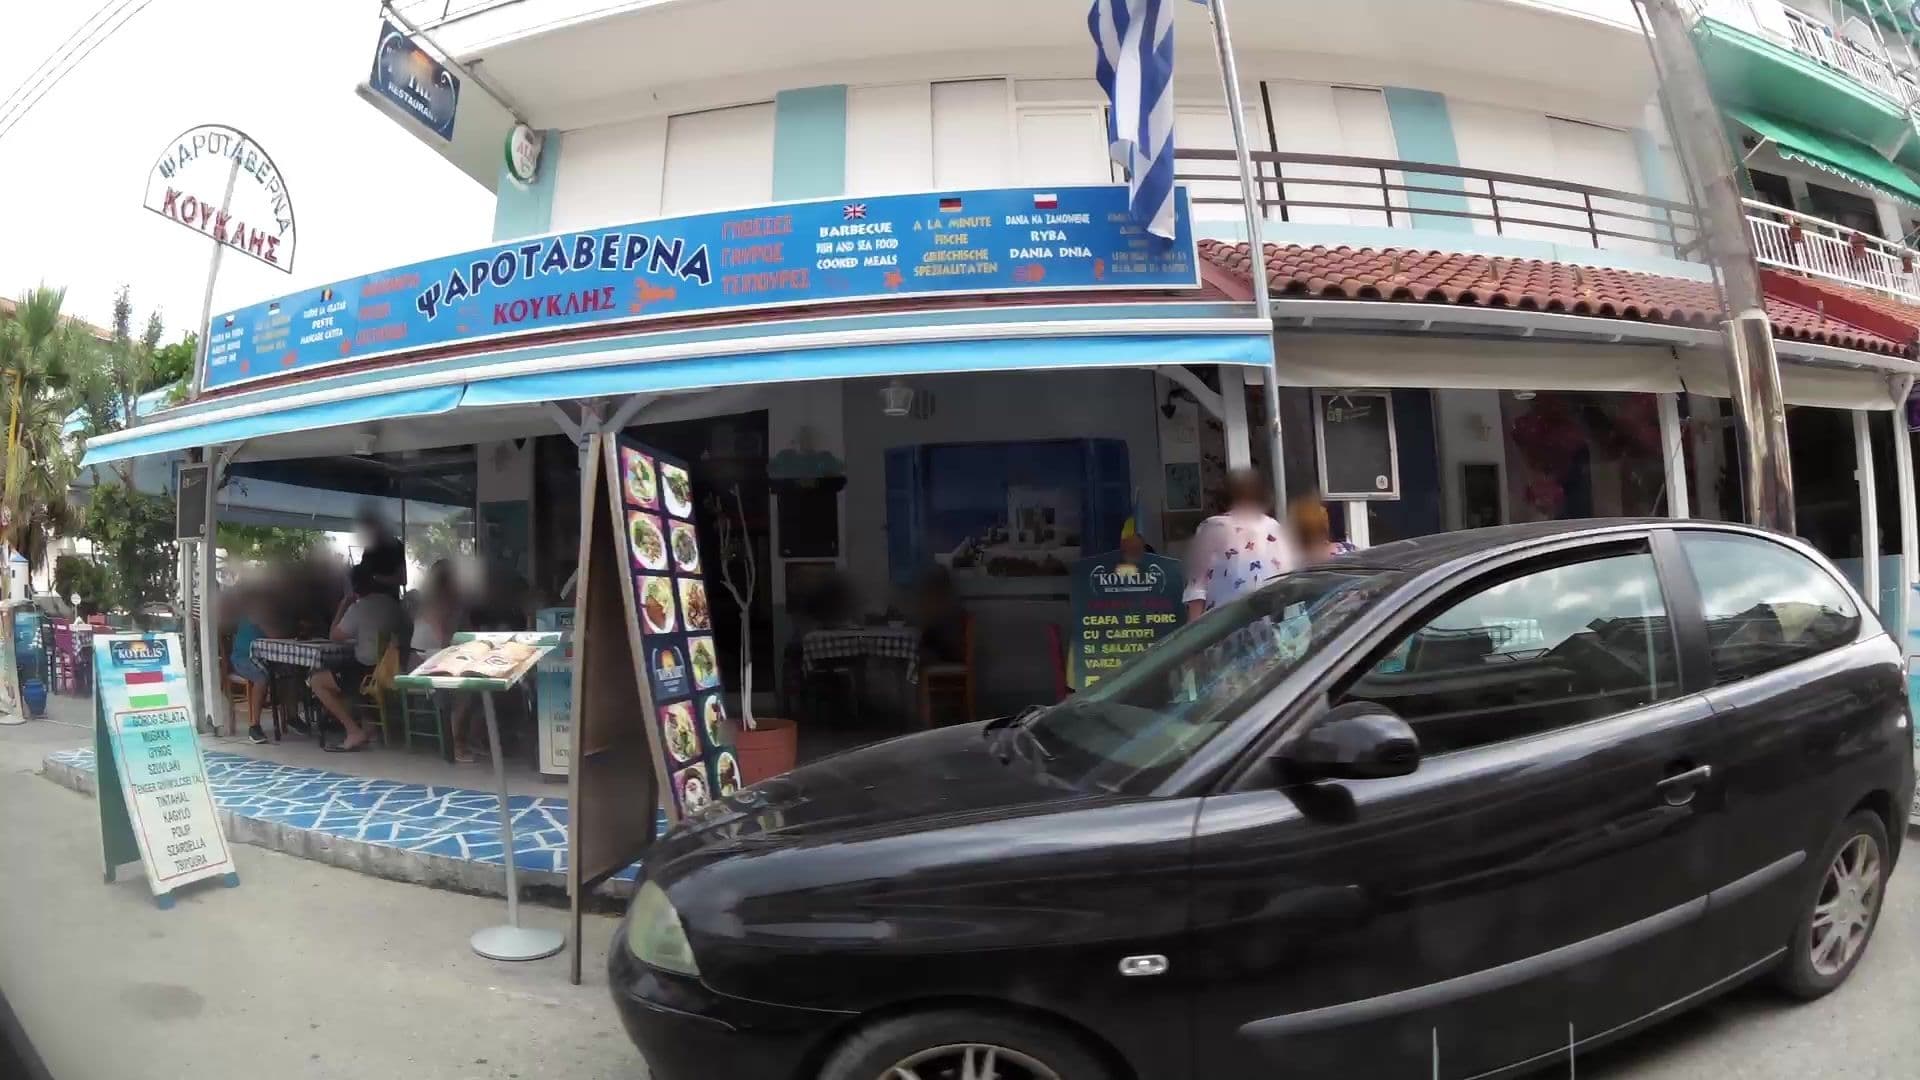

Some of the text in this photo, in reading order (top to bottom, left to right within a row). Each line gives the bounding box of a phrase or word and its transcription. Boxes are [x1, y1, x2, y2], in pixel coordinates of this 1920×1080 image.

[158, 131, 290, 237] ΨΑΡΟΤΑΒΕΡΝΑ
[162, 186, 281, 264] ΚΟΥΚΛΗΣ
[927, 218, 943, 230] LA
[948, 216, 992, 229] MINUTE
[1005, 214, 1030, 225] DANIA
[1031, 213, 1043, 224] NA
[819, 222, 893, 238] BARBECUE
[1030, 230, 1067, 242] RYBA
[836, 241, 855, 253] AND
[857, 239, 873, 251] SEA
[875, 238, 899, 250] FOOD
[935, 233, 969, 245] FISCHE
[1009, 246, 1093, 259] DANIA DNIA
[816, 254, 898, 270] COOKED MEALS
[416, 232, 712, 321] ΨΑΡΟΤΑΒΕΡΝΑ
[493, 286, 616, 325] ΚΟΥΚΛΗΣ
[1082, 615, 1119, 626] CEAFA
[1125, 615, 1141, 625] DE
[1083, 630, 1099, 640] CU
[1084, 644, 1096, 654] SI
[1102, 643, 1145, 654] SALATA
[155, 791, 190, 808] TINTAHAL
[166, 837, 207, 857] SZARDELLA
